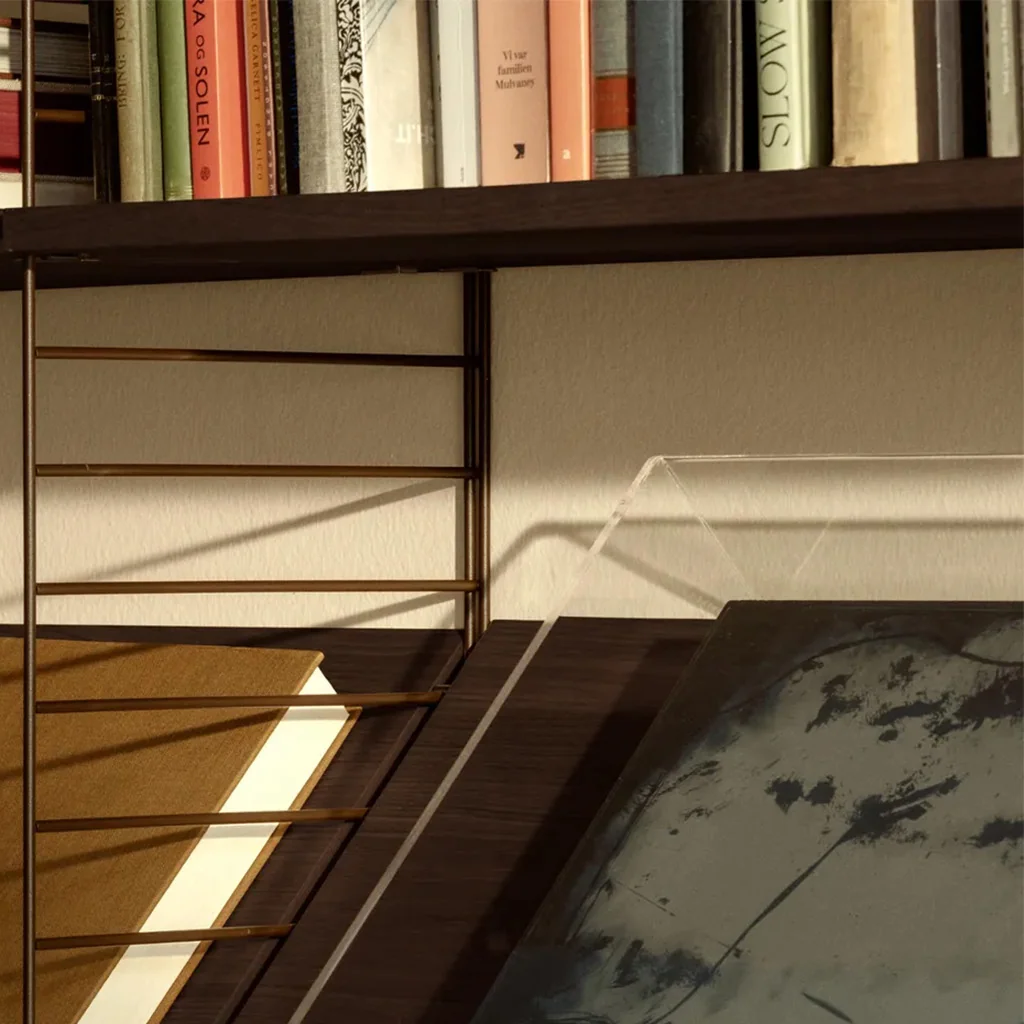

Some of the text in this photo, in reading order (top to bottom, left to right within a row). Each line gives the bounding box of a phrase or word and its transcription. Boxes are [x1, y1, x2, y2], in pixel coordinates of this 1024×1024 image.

[194, 34, 206, 60] OG
[513, 50, 528, 61] var
[251, 44, 262, 103] GARNETT
[497, 63, 533, 76] familien
[494, 77, 536, 91] Mulvaney
[757, 19, 791, 149] SLOW
[194, 65, 211, 147] SOLEN
